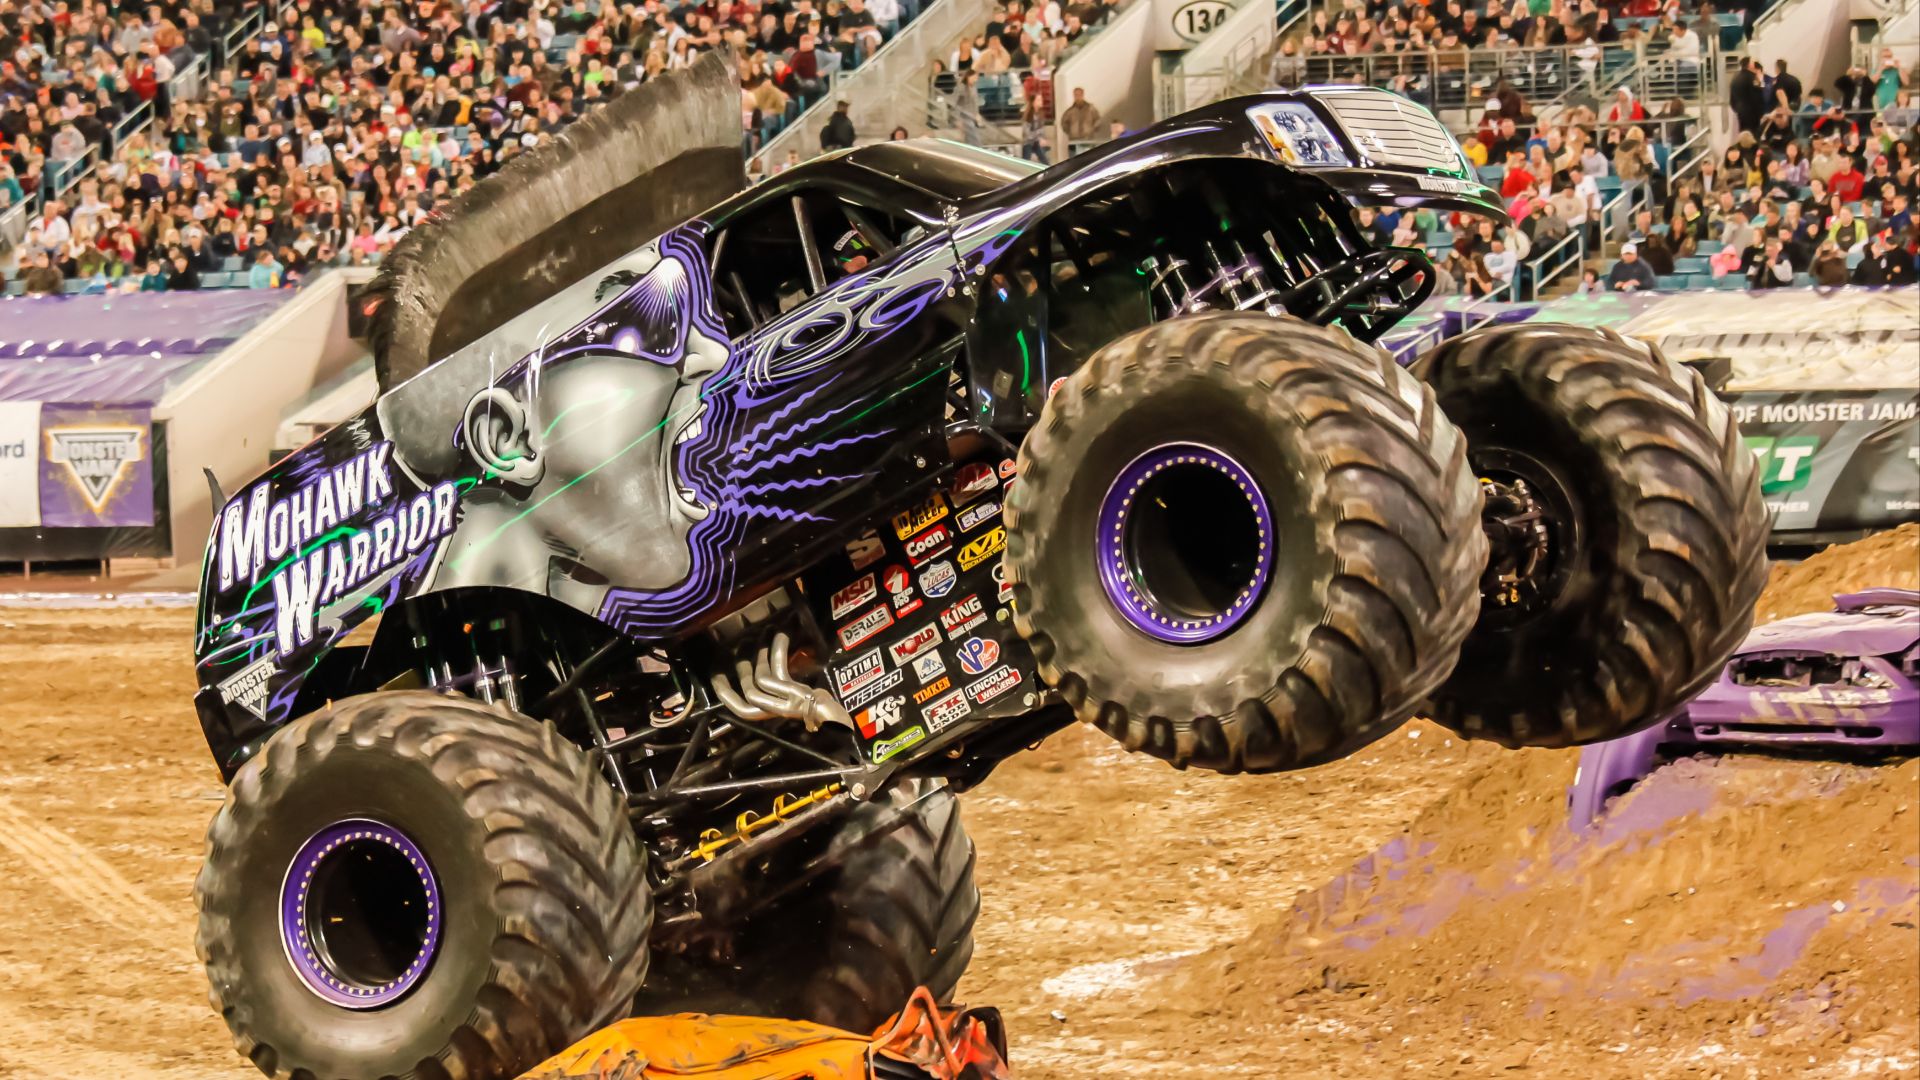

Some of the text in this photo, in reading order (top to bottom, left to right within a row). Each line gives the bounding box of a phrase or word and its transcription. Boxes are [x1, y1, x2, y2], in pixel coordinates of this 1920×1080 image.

[1735, 402, 1915, 424] OF MONSTER JAM
[0, 440, 25, 459] rd
[218, 440, 394, 594] MOHAWK
[906, 530, 945, 557] Coan
[273, 480, 457, 658] WARRIOR
[926, 567, 951, 588] LUCAS
[833, 575, 874, 611] MSD
[843, 609, 886, 641] DERALE
[941, 597, 983, 629] KING
[894, 627, 935, 658] WORLD
[957, 637, 985, 673] VP
[220, 661, 276, 706] MONSTER
[839, 654, 880, 685] OPTIMA
[967, 668, 1010, 698] LINCOLN
[237, 682, 267, 708] JAM
[912, 677, 951, 705] TIMKEN
[980, 676, 1016, 700] WELDERS
[867, 695, 906, 734] K&N
[932, 708, 968, 731] ENDS
[938, 702, 965, 721] ROD
